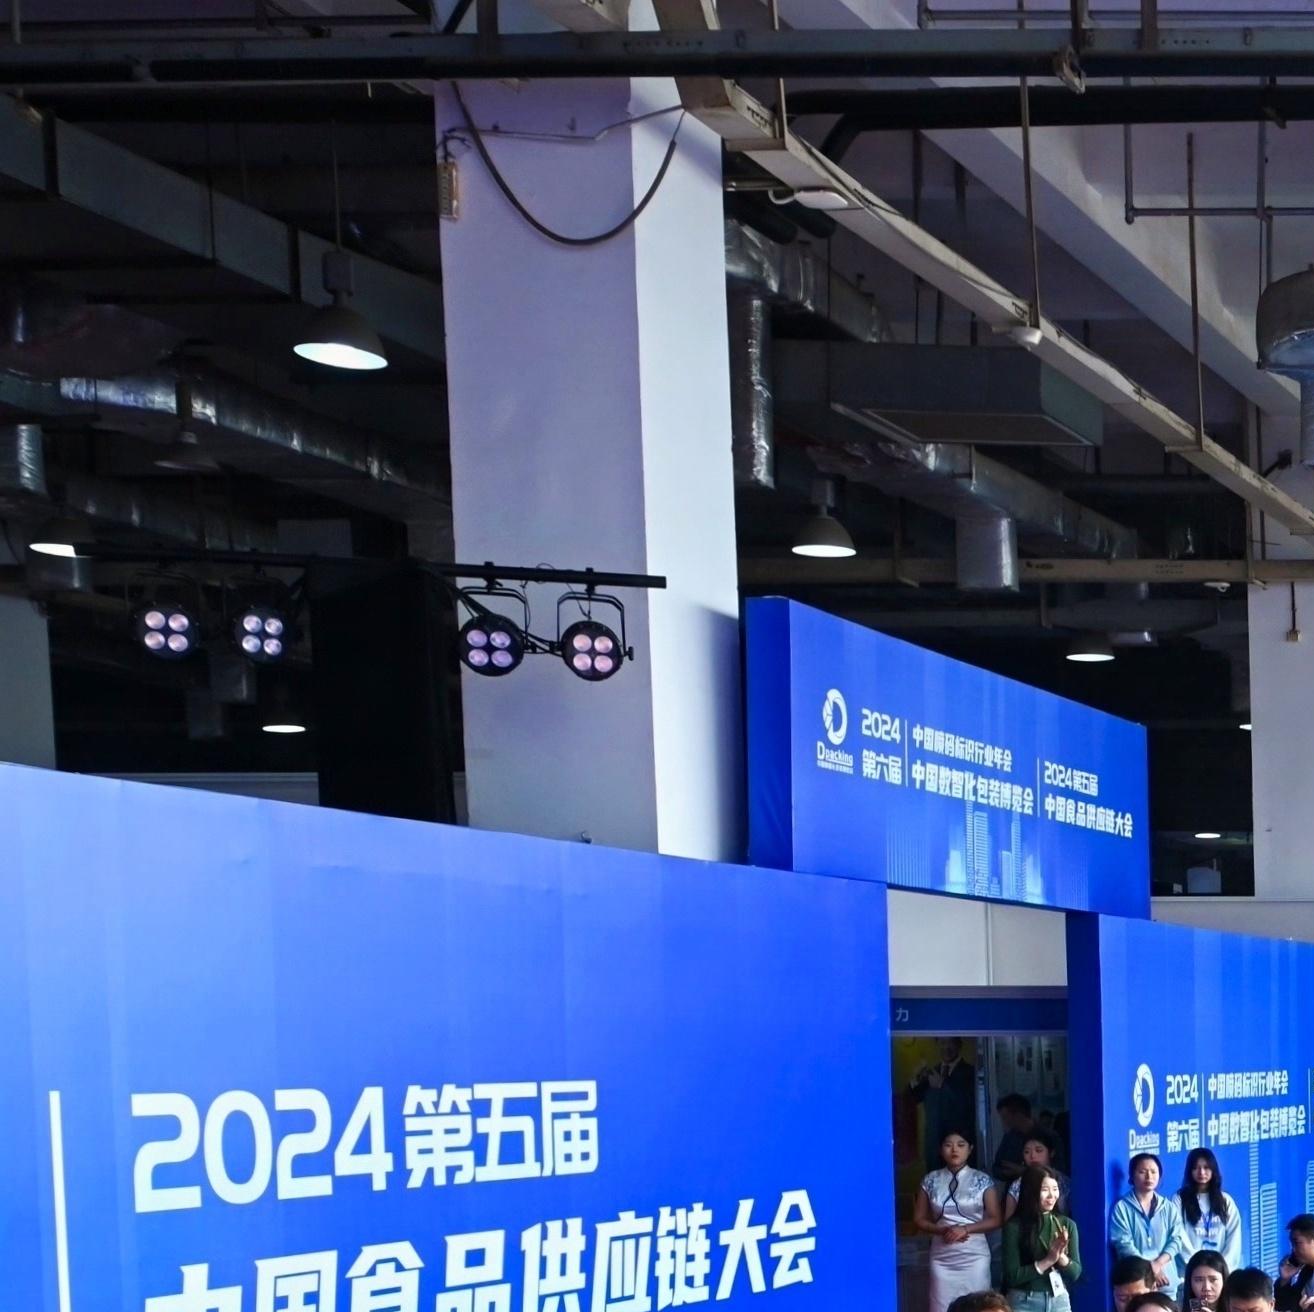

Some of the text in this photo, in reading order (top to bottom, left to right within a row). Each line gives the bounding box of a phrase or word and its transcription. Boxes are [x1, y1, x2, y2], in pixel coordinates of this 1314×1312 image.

[861, 708, 902, 745] 2024
[816, 740, 854, 767] Dpacking
[911, 723, 1013, 774] 中国喷码标识行业年会
[862, 749, 902, 785] 第六届
[910, 758, 1034, 816] 中国数智化包装博览会
[1044, 797, 1134, 839] 中国食品供应链大会
[1166, 1074, 1199, 1105] 2024
[1208, 1070, 1289, 1100] 中国喷码标识行业年会
[1166, 1119, 1200, 1153] 第六届
[1207, 1104, 1306, 1147] 中国数智化包装博览会
